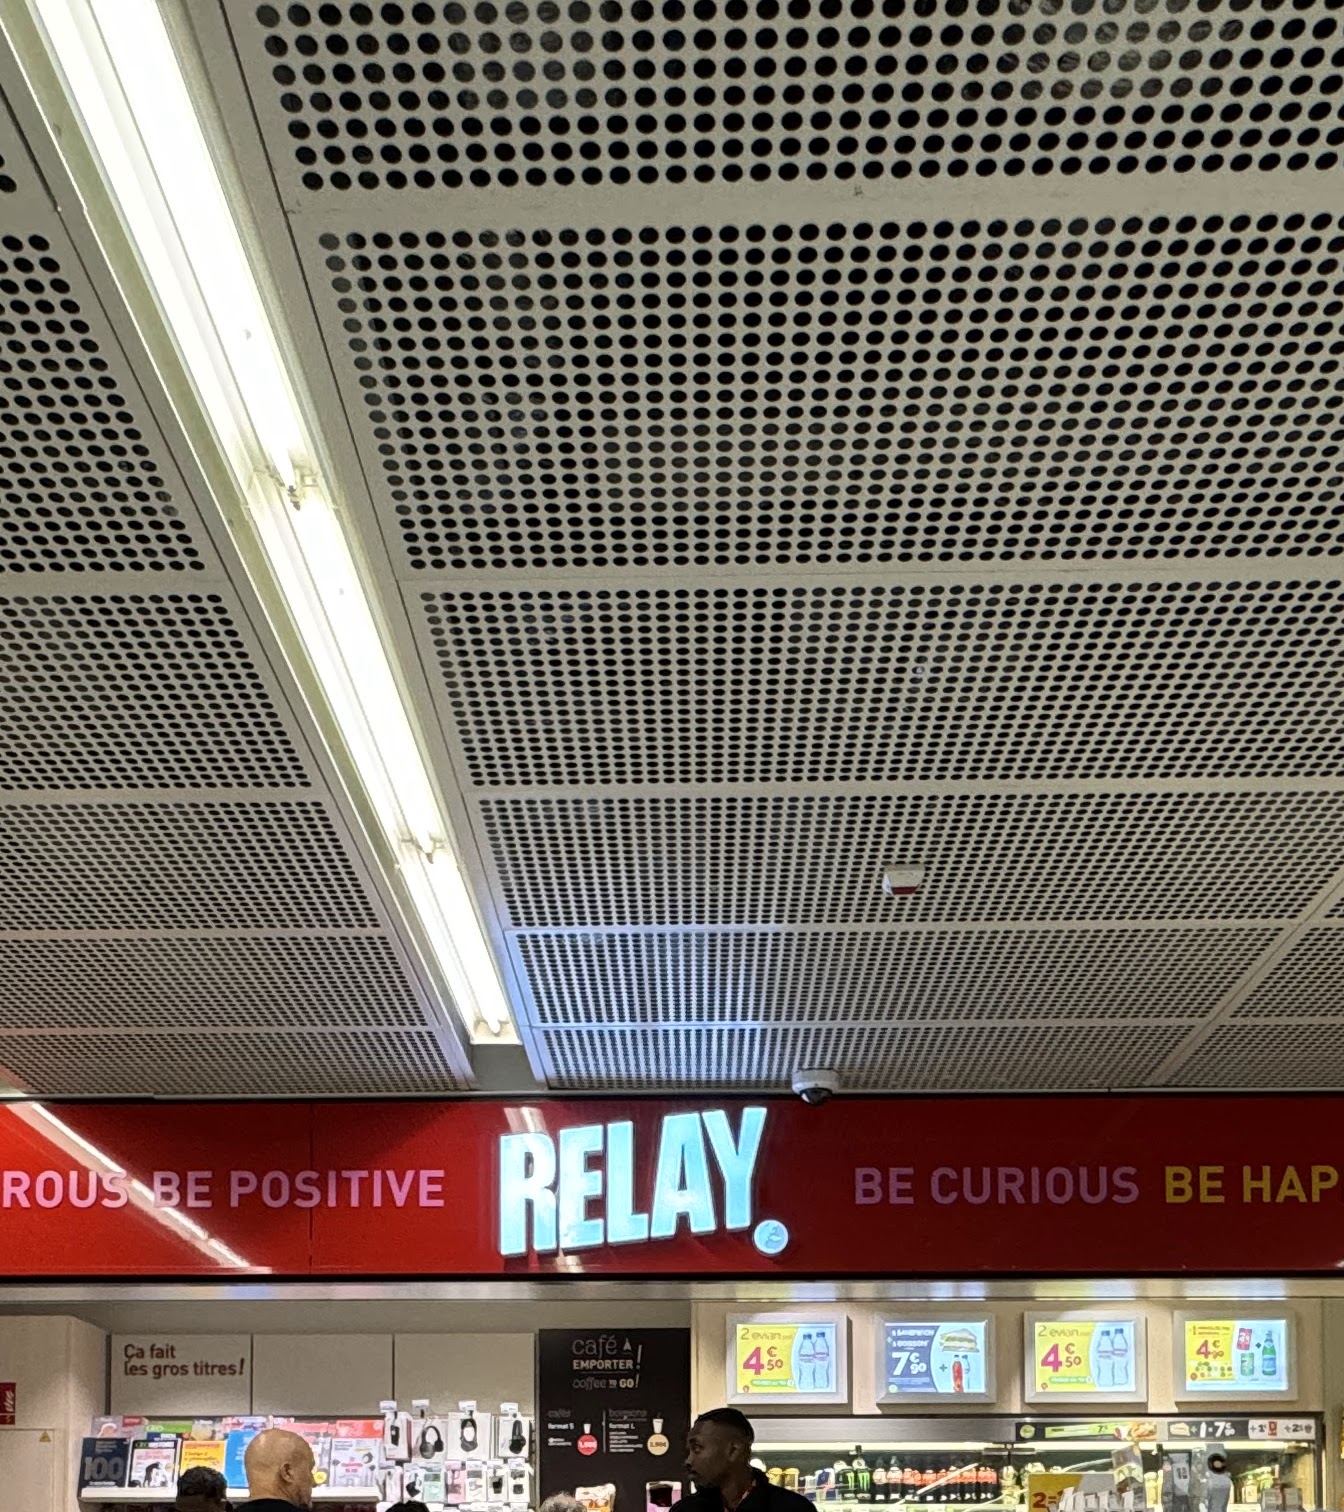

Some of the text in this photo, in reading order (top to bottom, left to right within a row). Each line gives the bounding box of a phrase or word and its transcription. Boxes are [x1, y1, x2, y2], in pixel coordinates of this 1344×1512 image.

[153, 1170, 213, 1208] BE
[230, 1169, 445, 1208] POSITIVE
[855, 1167, 915, 1205] BE
[930, 1166, 1139, 1205] CURIOUS
[1165, 1165, 1225, 1203] BE
[124, 1343, 176, 1363] Ça fait
[572, 1335, 618, 1359] café
[124, 1360, 148, 1376] les
[152, 1364, 189, 1380] gros
[572, 1359, 634, 1370] EMPORTER
[83, 1456, 124, 1481] 100
